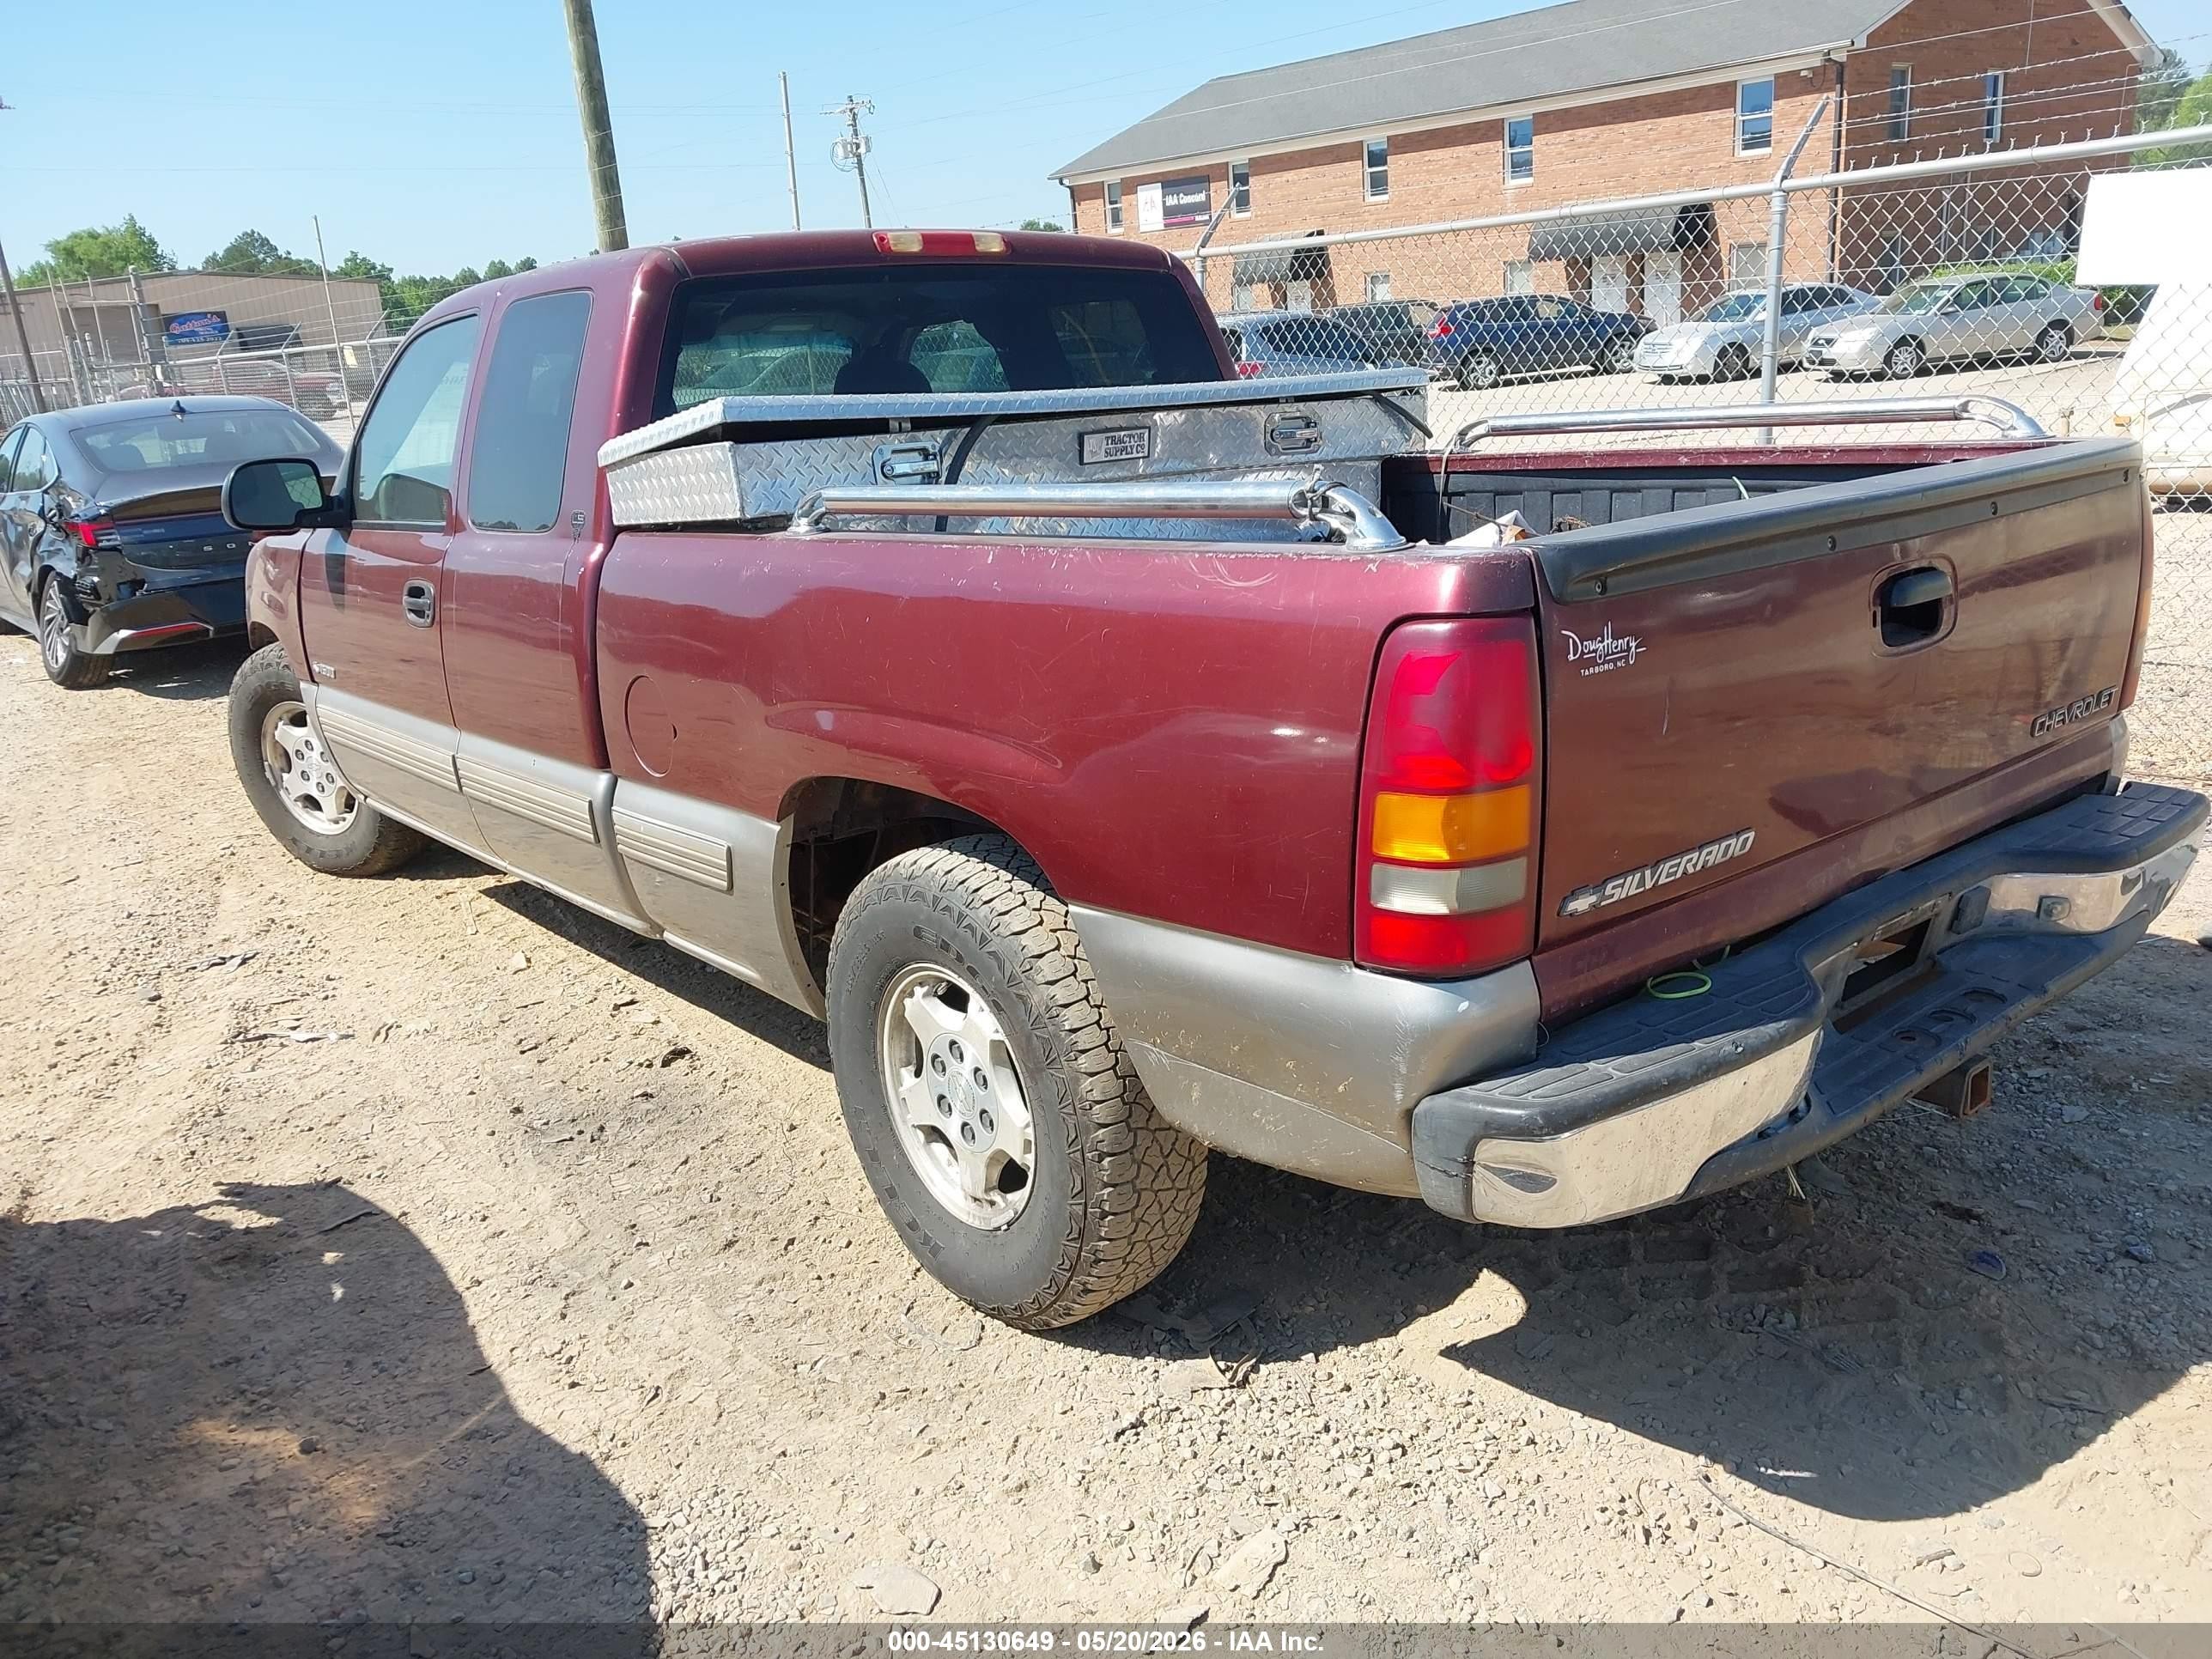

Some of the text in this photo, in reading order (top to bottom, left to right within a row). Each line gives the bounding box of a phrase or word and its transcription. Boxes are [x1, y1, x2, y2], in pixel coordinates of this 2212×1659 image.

[1165, 193, 1178, 206] IAA
[1179, 190, 1206, 204] Concord
[1104, 432, 1146, 446] TRACTOR
[1103, 444, 1135, 458] SUPPLY
[1580, 659, 1626, 678] TARBORO, NC
[2034, 686, 2119, 738] CHEVROLET
[1600, 830, 1756, 907] SILVERADO
